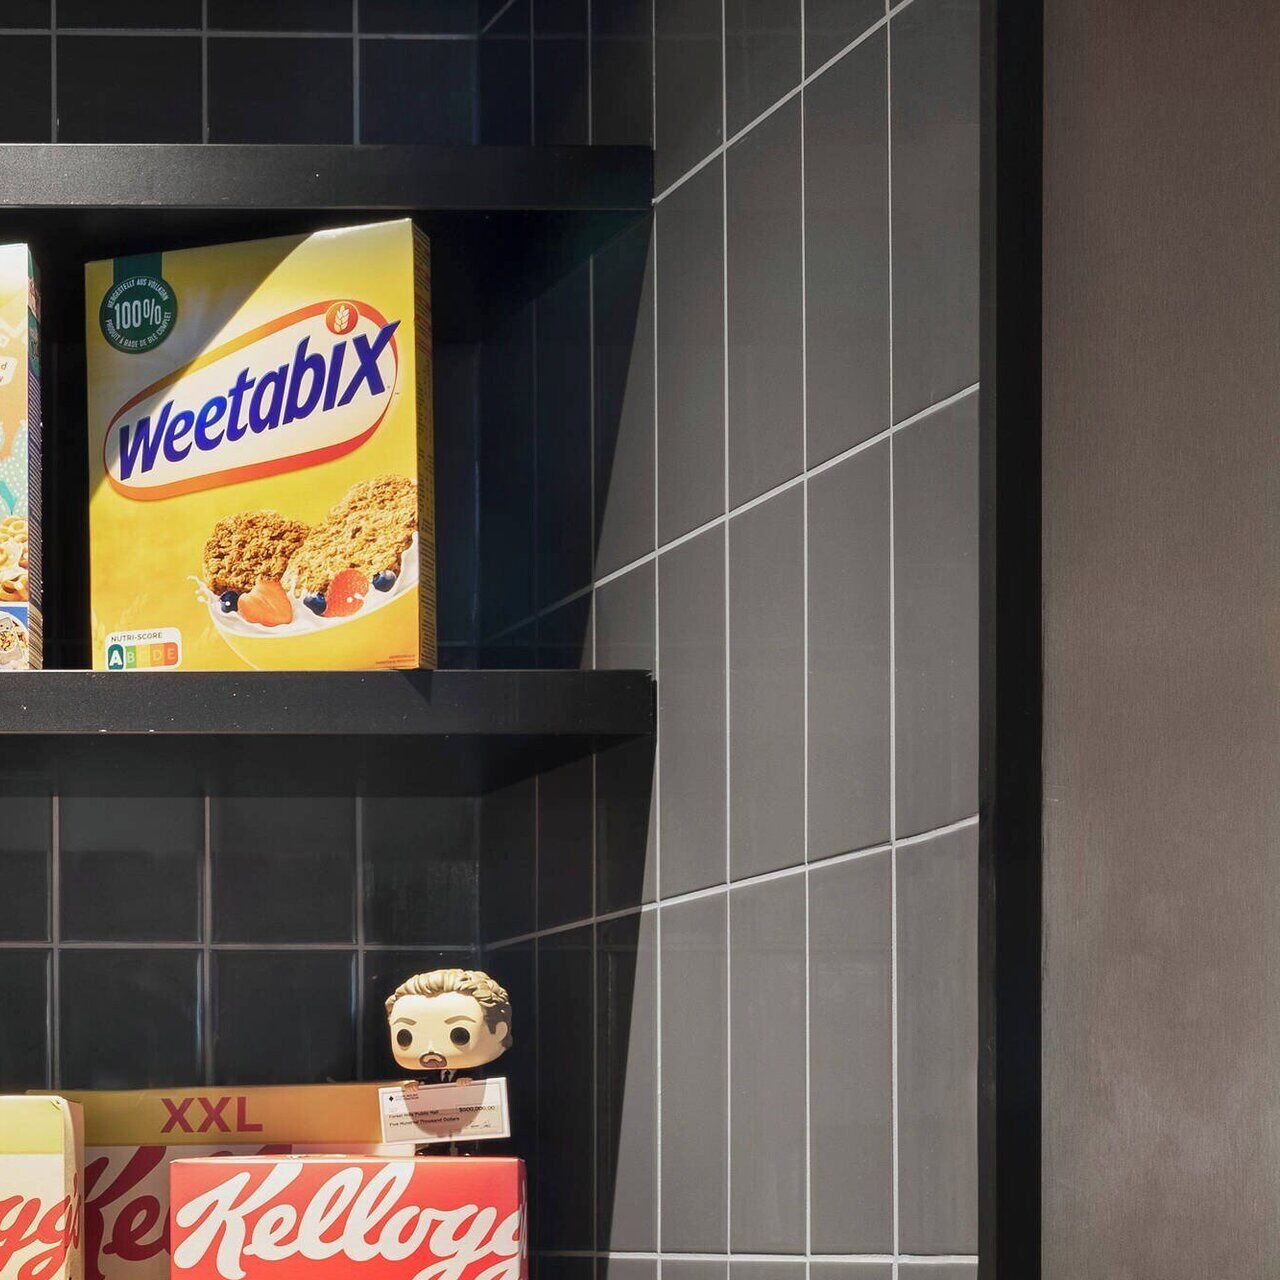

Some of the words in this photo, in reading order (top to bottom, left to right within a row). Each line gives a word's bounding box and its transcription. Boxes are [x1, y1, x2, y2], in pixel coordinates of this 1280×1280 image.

[114, 298, 162, 330] 100%
[118, 320, 401, 480] Weetabix
[111, 632, 163, 642] NUTRI-SCORE
[160, 1097, 263, 1133] XXL
